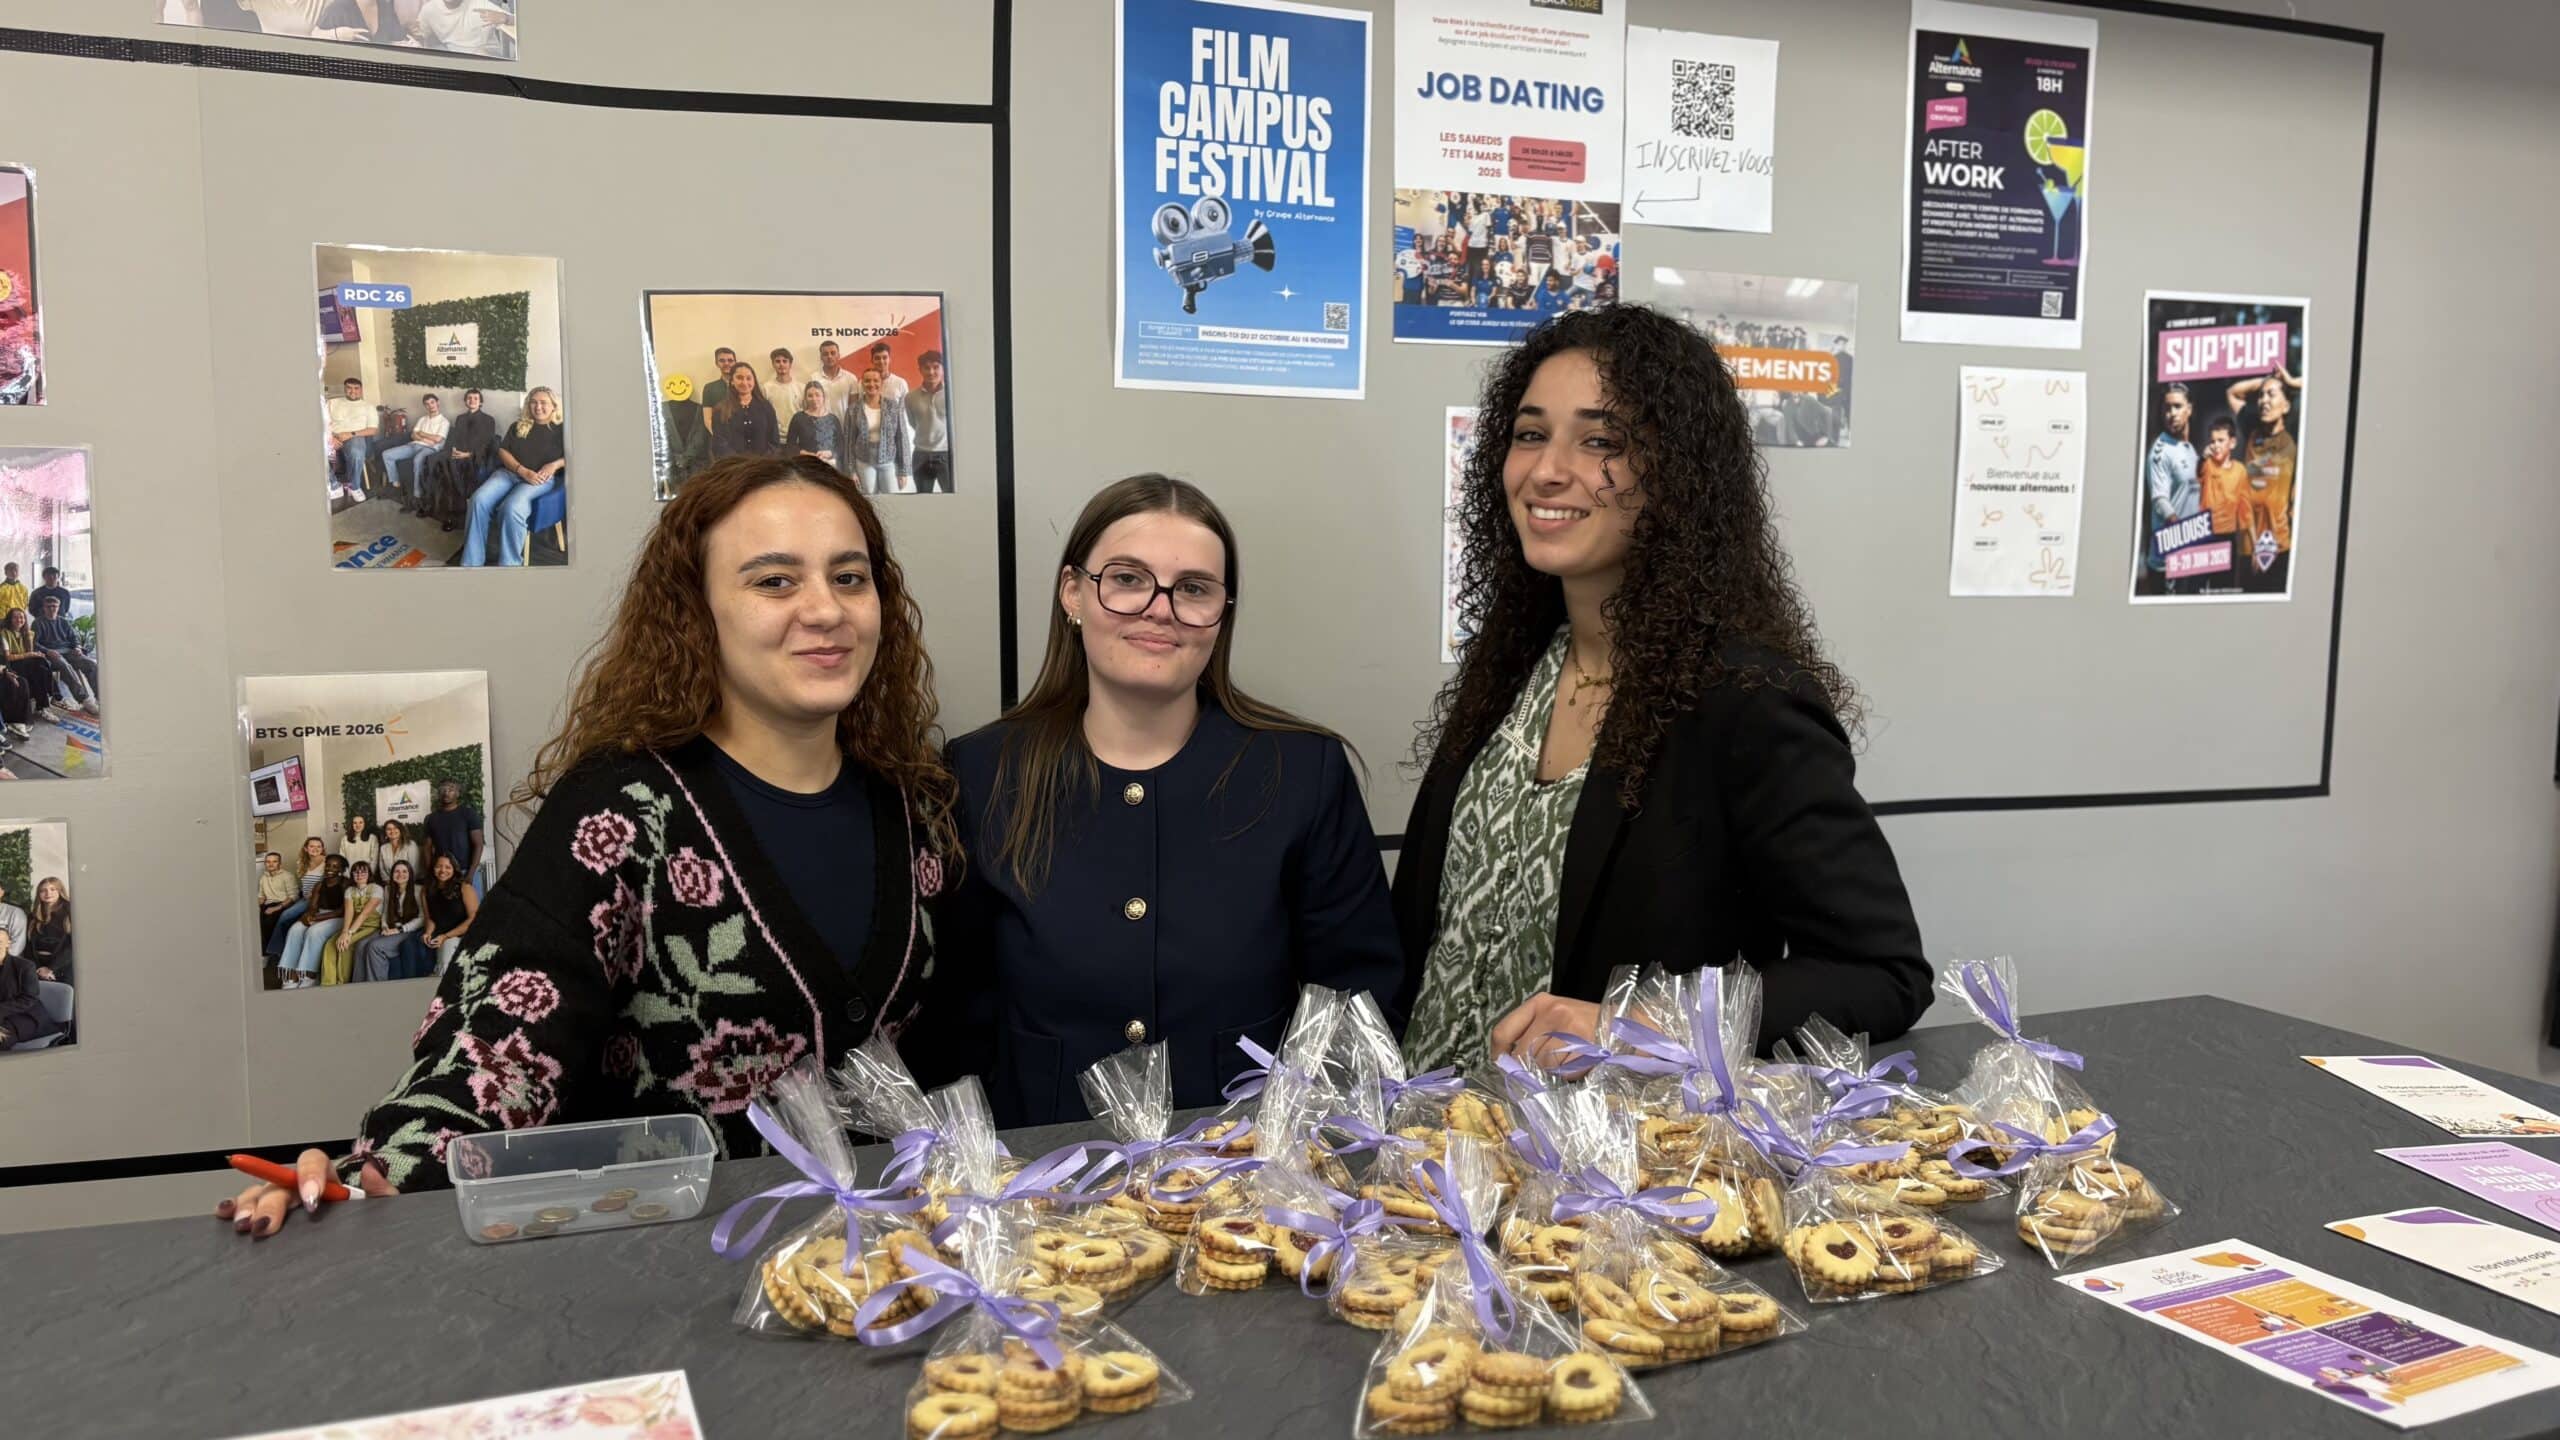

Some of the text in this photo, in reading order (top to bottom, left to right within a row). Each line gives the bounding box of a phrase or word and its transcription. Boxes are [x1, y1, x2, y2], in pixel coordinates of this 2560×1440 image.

[1192, 27, 1289, 92] FILM
[1928, 61, 1982, 77] Alternance
[1417, 71, 1604, 114] JOB DATING
[2036, 76, 2063, 93] 18H
[1159, 80, 1332, 151] CAMPUS
[1440, 132, 1503, 146] LES SAMEDIS
[1442, 148, 1448, 158] 7
[1449, 148, 1461, 159] ET
[1462, 149, 1474, 160] 14
[1475, 150, 1504, 162] MARS
[1924, 139, 1983, 160] AFTER
[1155, 137, 1335, 207] FESTIVAL
[1923, 161, 2005, 189] WORK
[344, 288, 406, 303] RDC 26
[811, 327, 898, 337] BTS NDRC 2026
[2165, 330, 2280, 375] SUP'CUP
[1986, 468, 2060, 480] Bienvenue aux
[1970, 481, 2017, 492] nouveaux
[2019, 482, 2069, 493] alternants
[2155, 513, 2212, 554] TOULOUSE
[255, 723, 385, 739] BTS GPME 2026
